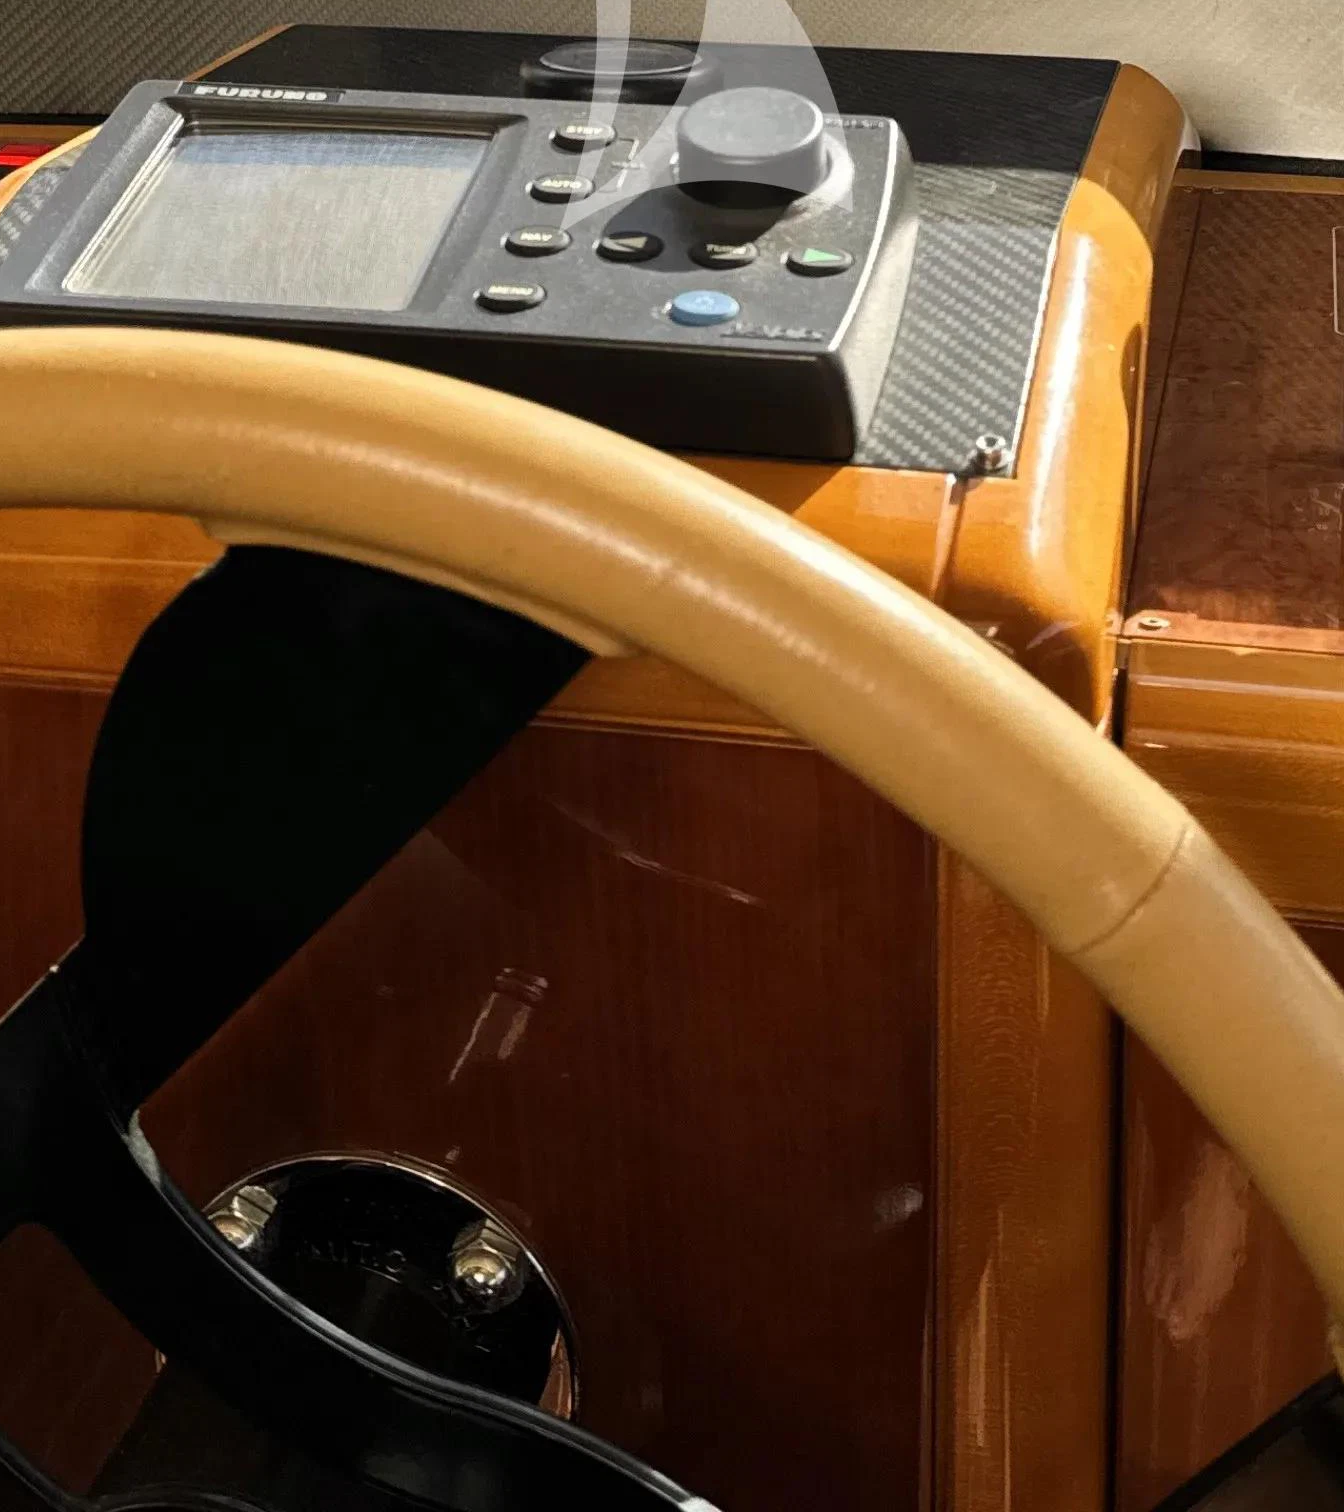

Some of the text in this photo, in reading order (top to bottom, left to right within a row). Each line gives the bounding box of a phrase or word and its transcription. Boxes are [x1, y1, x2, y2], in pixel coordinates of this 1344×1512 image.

[194, 85, 327, 101] FURUNO
[540, 180, 582, 189] AUTO
[520, 232, 553, 241] NAV
[488, 285, 534, 296] MENU
